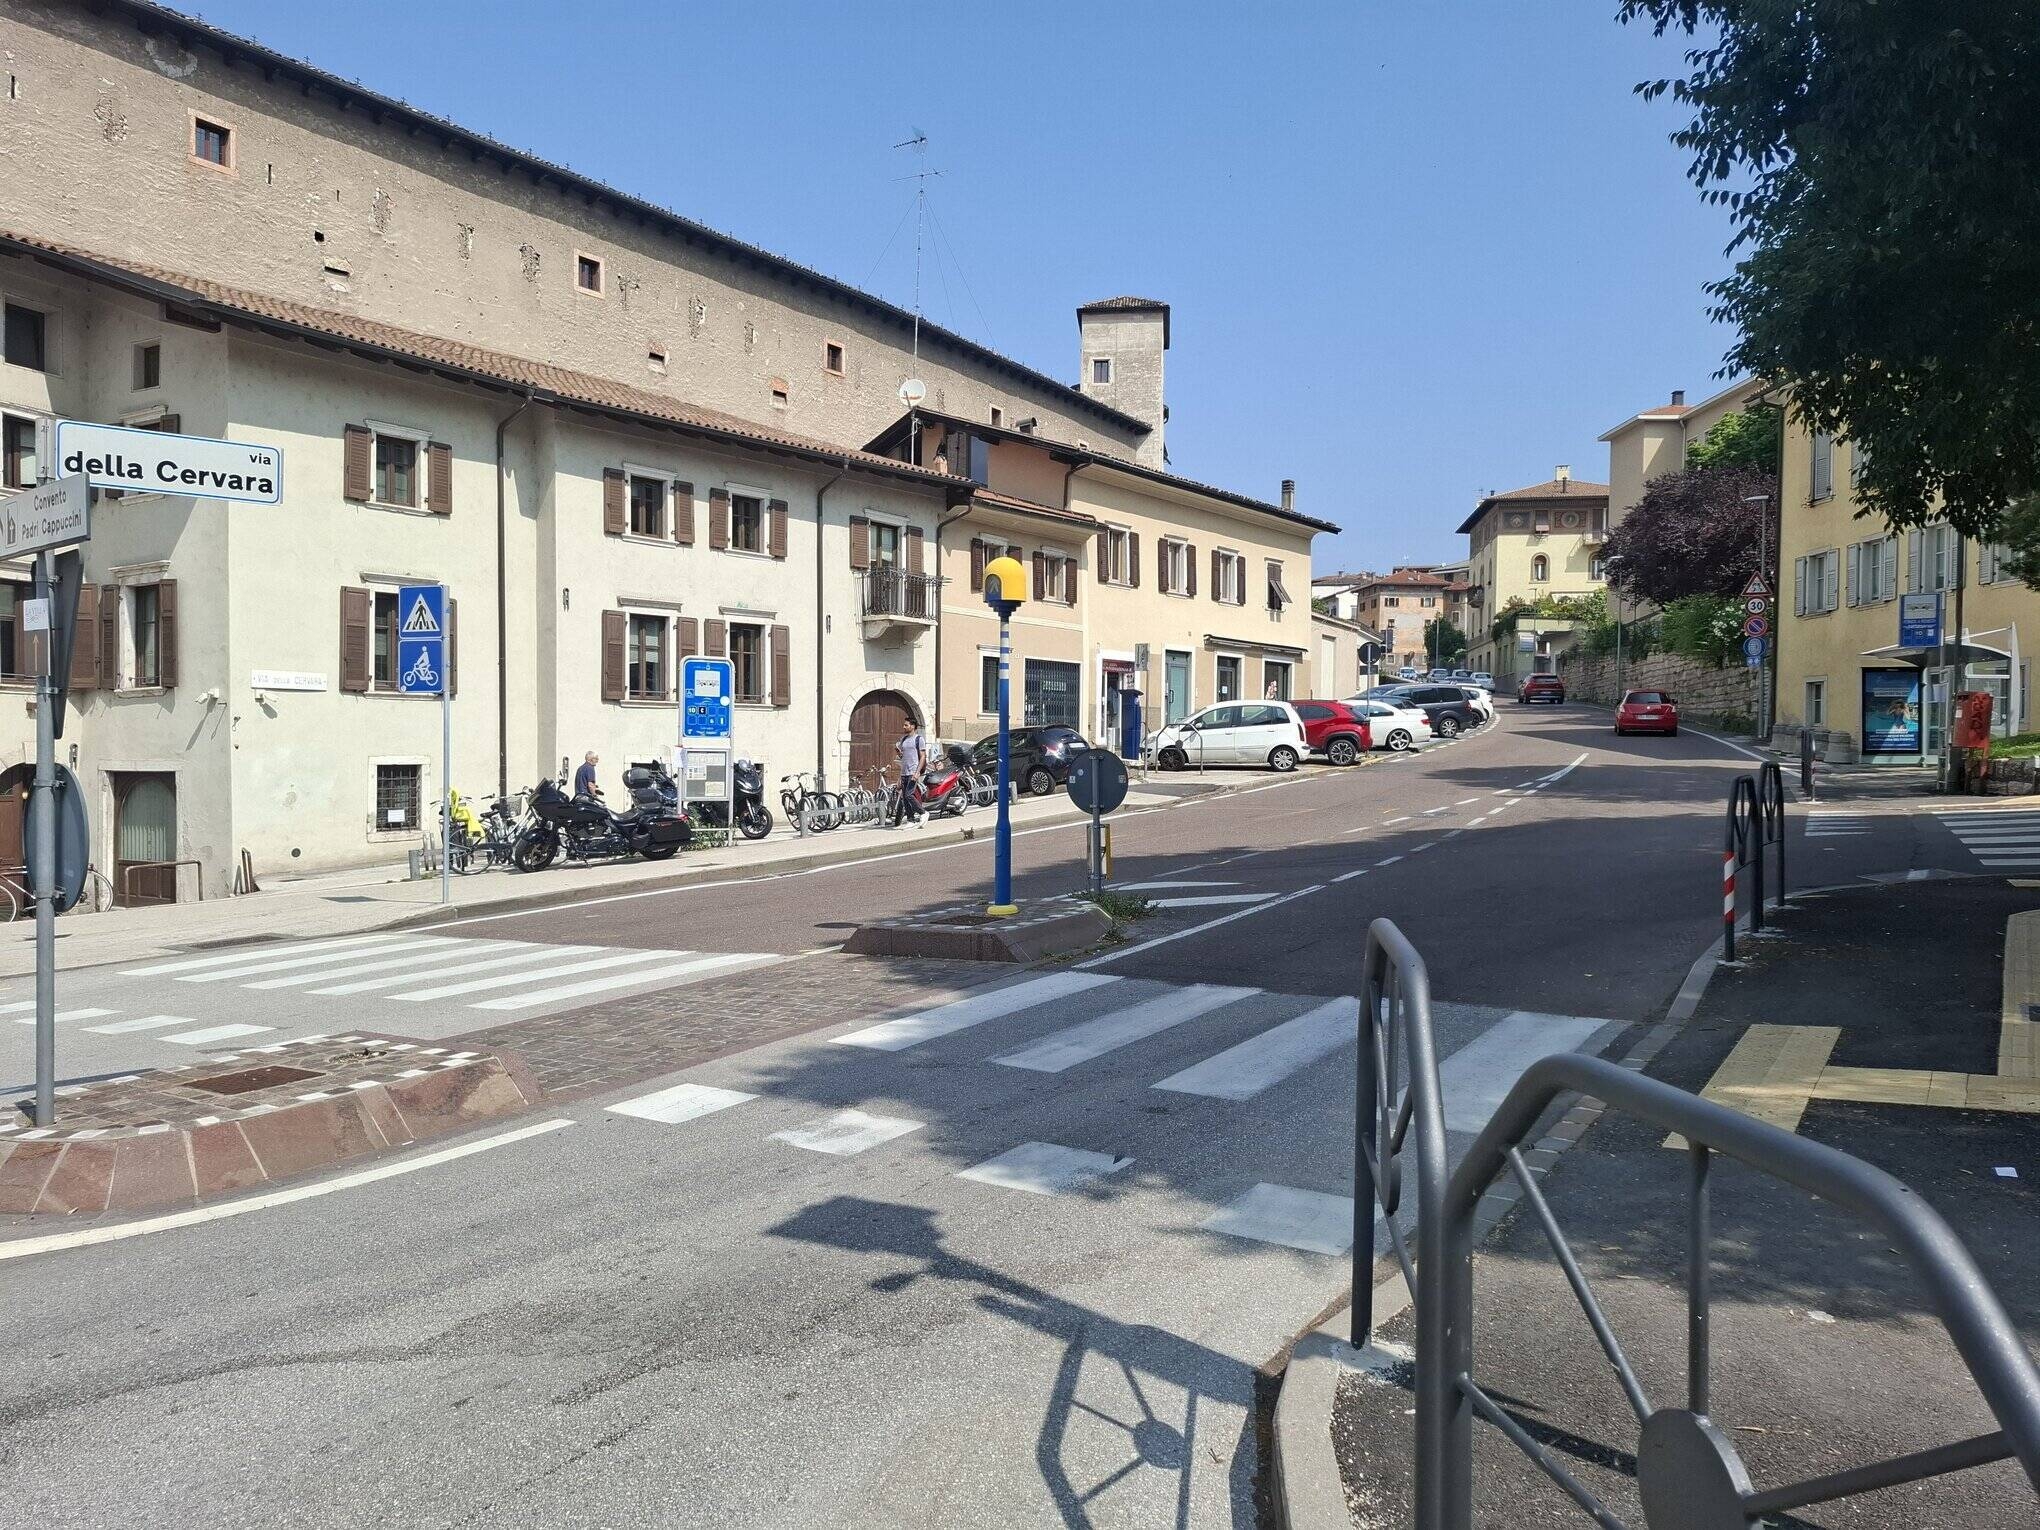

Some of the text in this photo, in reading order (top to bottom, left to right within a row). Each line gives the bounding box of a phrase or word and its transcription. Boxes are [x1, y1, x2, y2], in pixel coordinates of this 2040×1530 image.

[249, 453, 271, 465] via
[64, 450, 274, 494] della Cervara
[34, 490, 67, 511] Convento
[22, 508, 82, 541] Padri Cappuccini
[1750, 601, 1763, 611] 30
